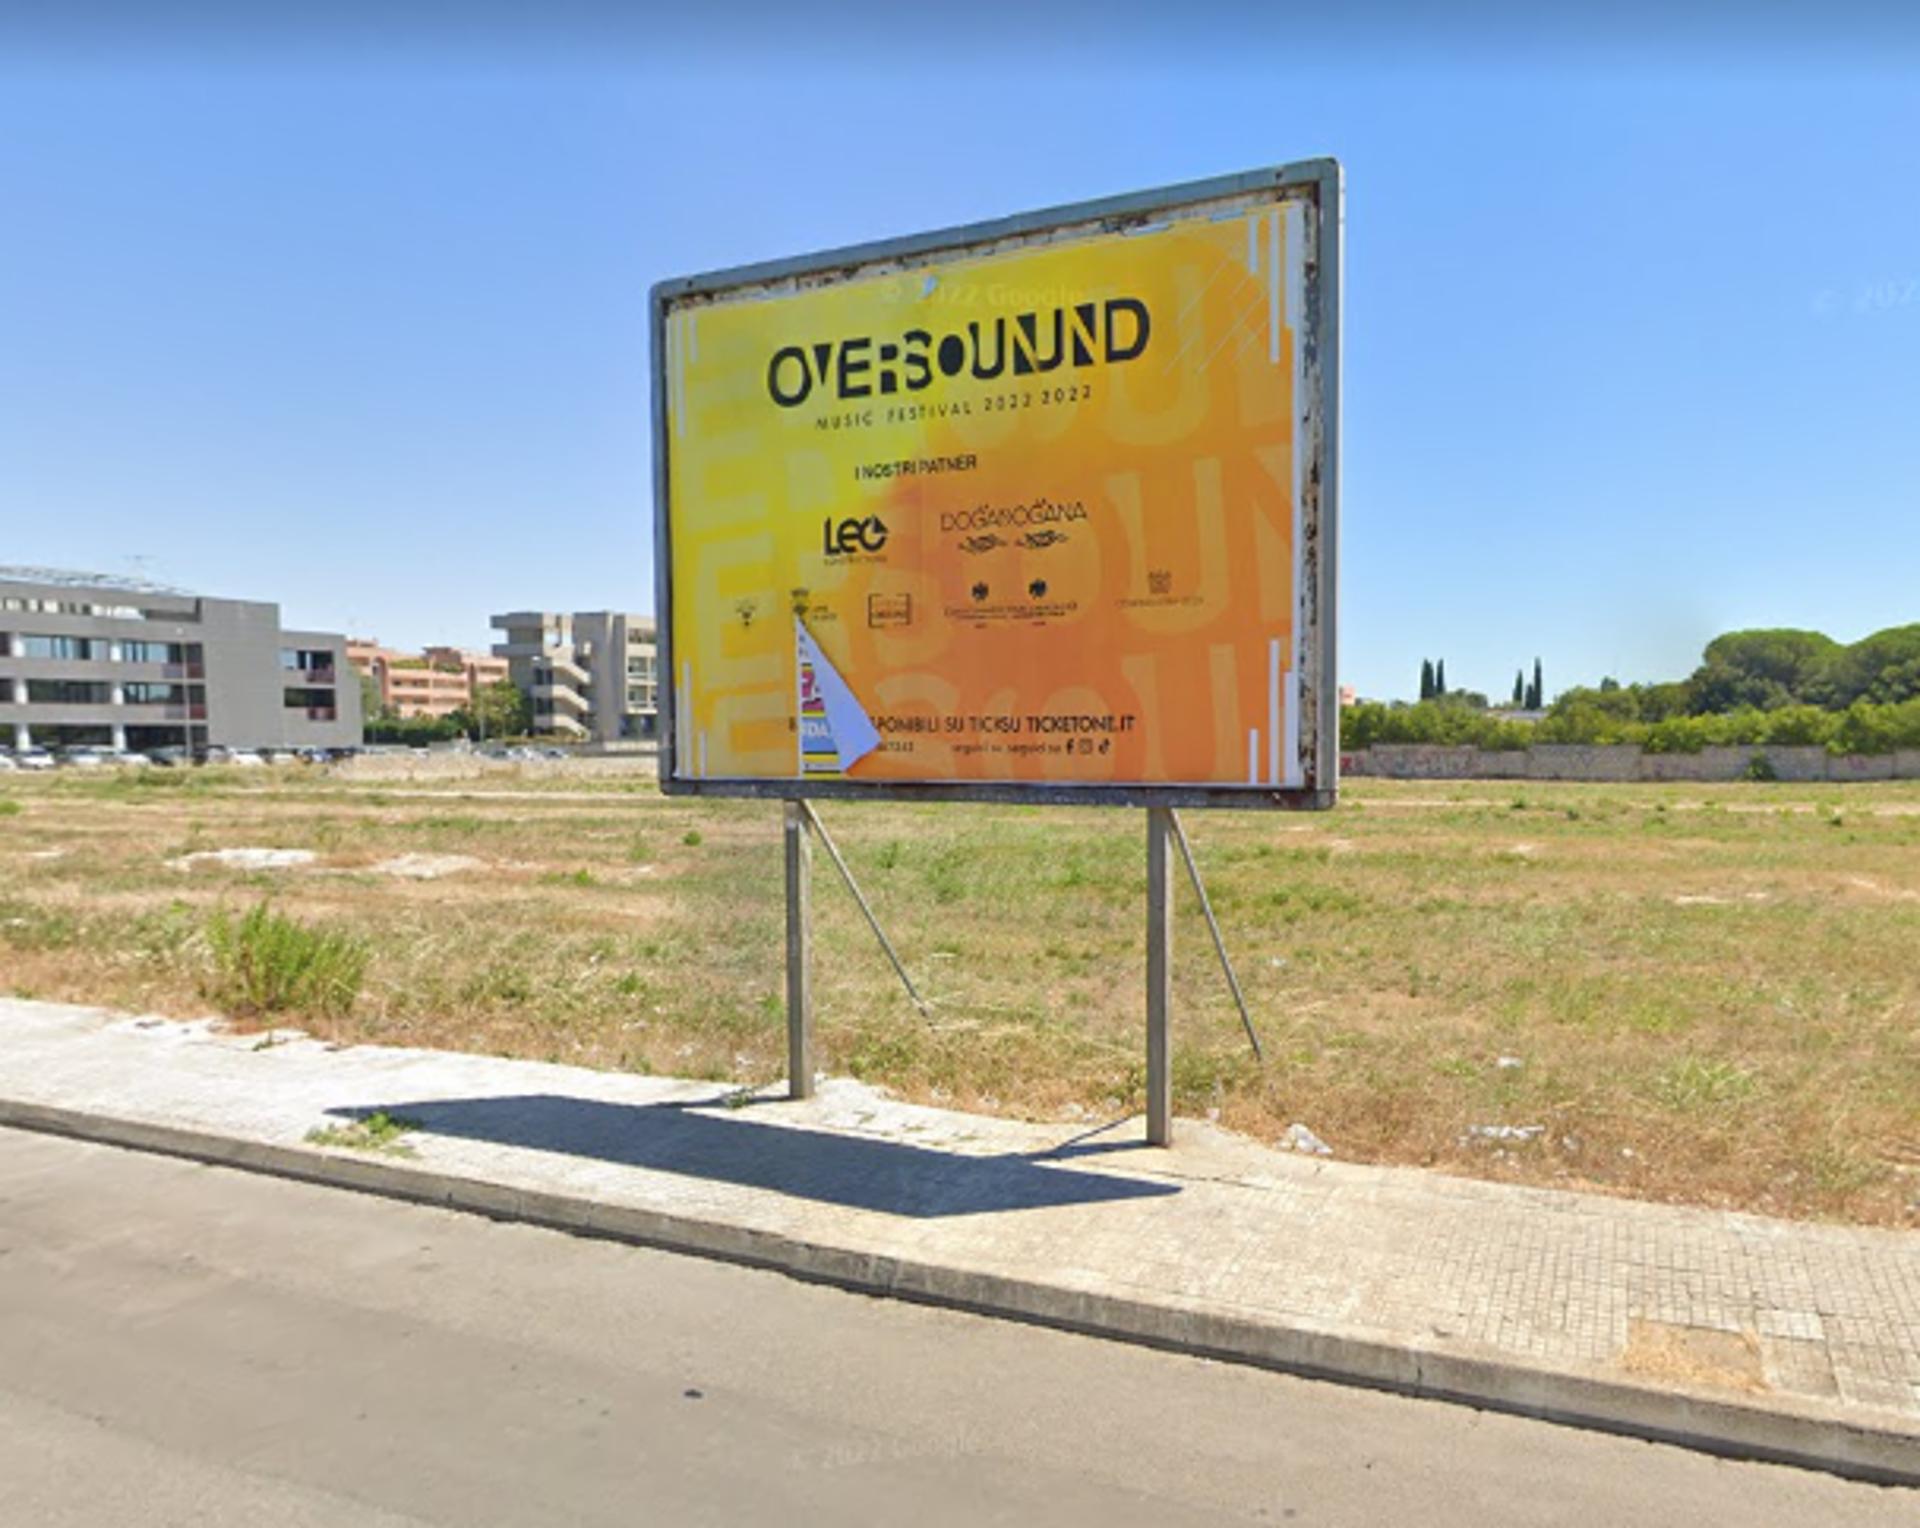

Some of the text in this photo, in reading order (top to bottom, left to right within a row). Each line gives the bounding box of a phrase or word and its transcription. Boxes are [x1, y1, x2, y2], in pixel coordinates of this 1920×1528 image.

[814, 409, 874, 431] MUSIC
[886, 400, 972, 425] FESTIVAL
[1026, 715, 1136, 734] TICKETONE.IT
